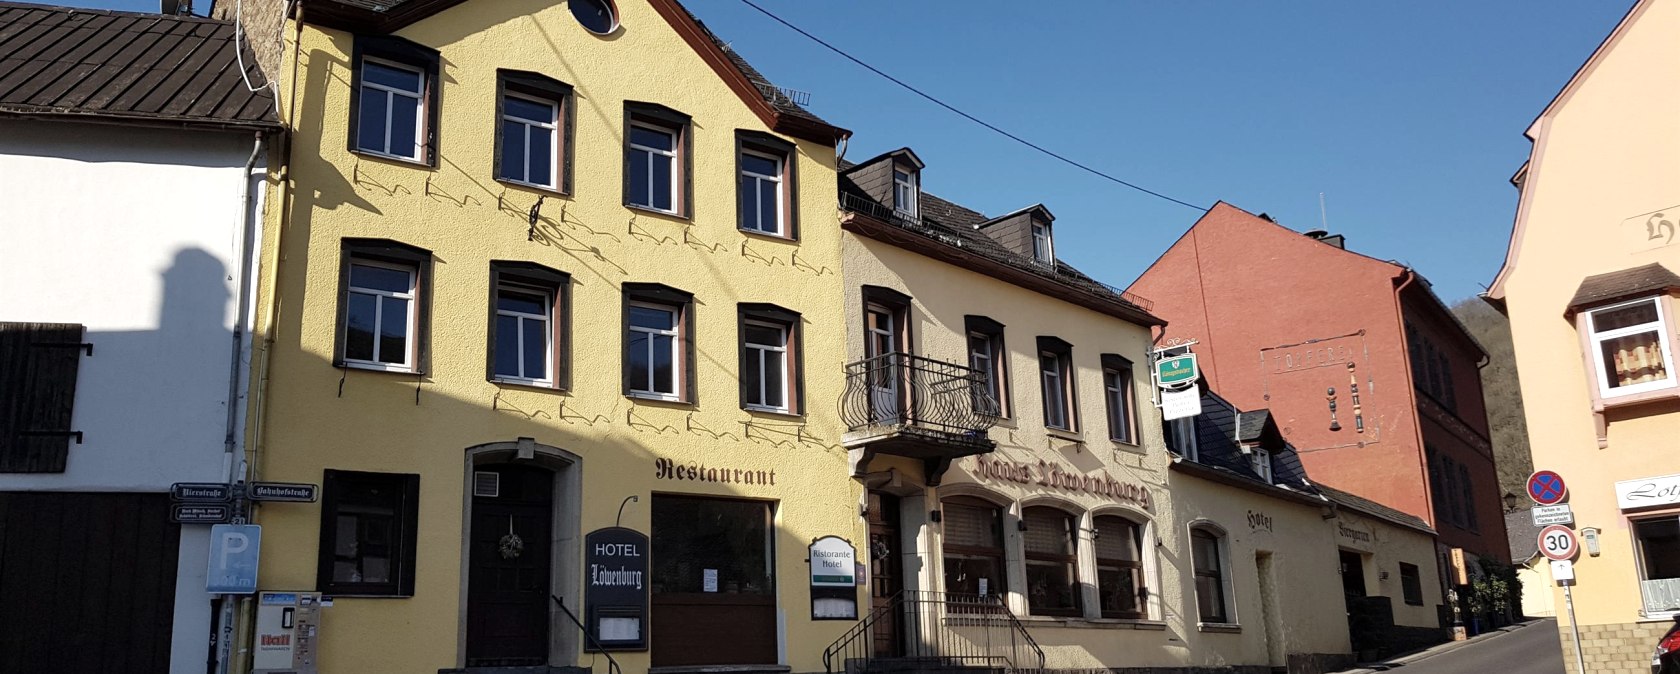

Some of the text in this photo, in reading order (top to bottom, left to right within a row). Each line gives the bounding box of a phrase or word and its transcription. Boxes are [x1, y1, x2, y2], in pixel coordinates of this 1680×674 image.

[655, 456, 776, 487] Restaurant
[257, 486, 310, 497] Bahnhofstraße
[1033, 458, 1149, 511] Löwenburg
[1247, 509, 1273, 533] Hotel
[219, 532, 249, 570] P
[595, 543, 641, 557] HOTEL
[1546, 534, 1569, 551] 30
[813, 549, 851, 559] Ristorante
[822, 559, 843, 568] Hotel
[591, 564, 642, 590] Löwenburg
